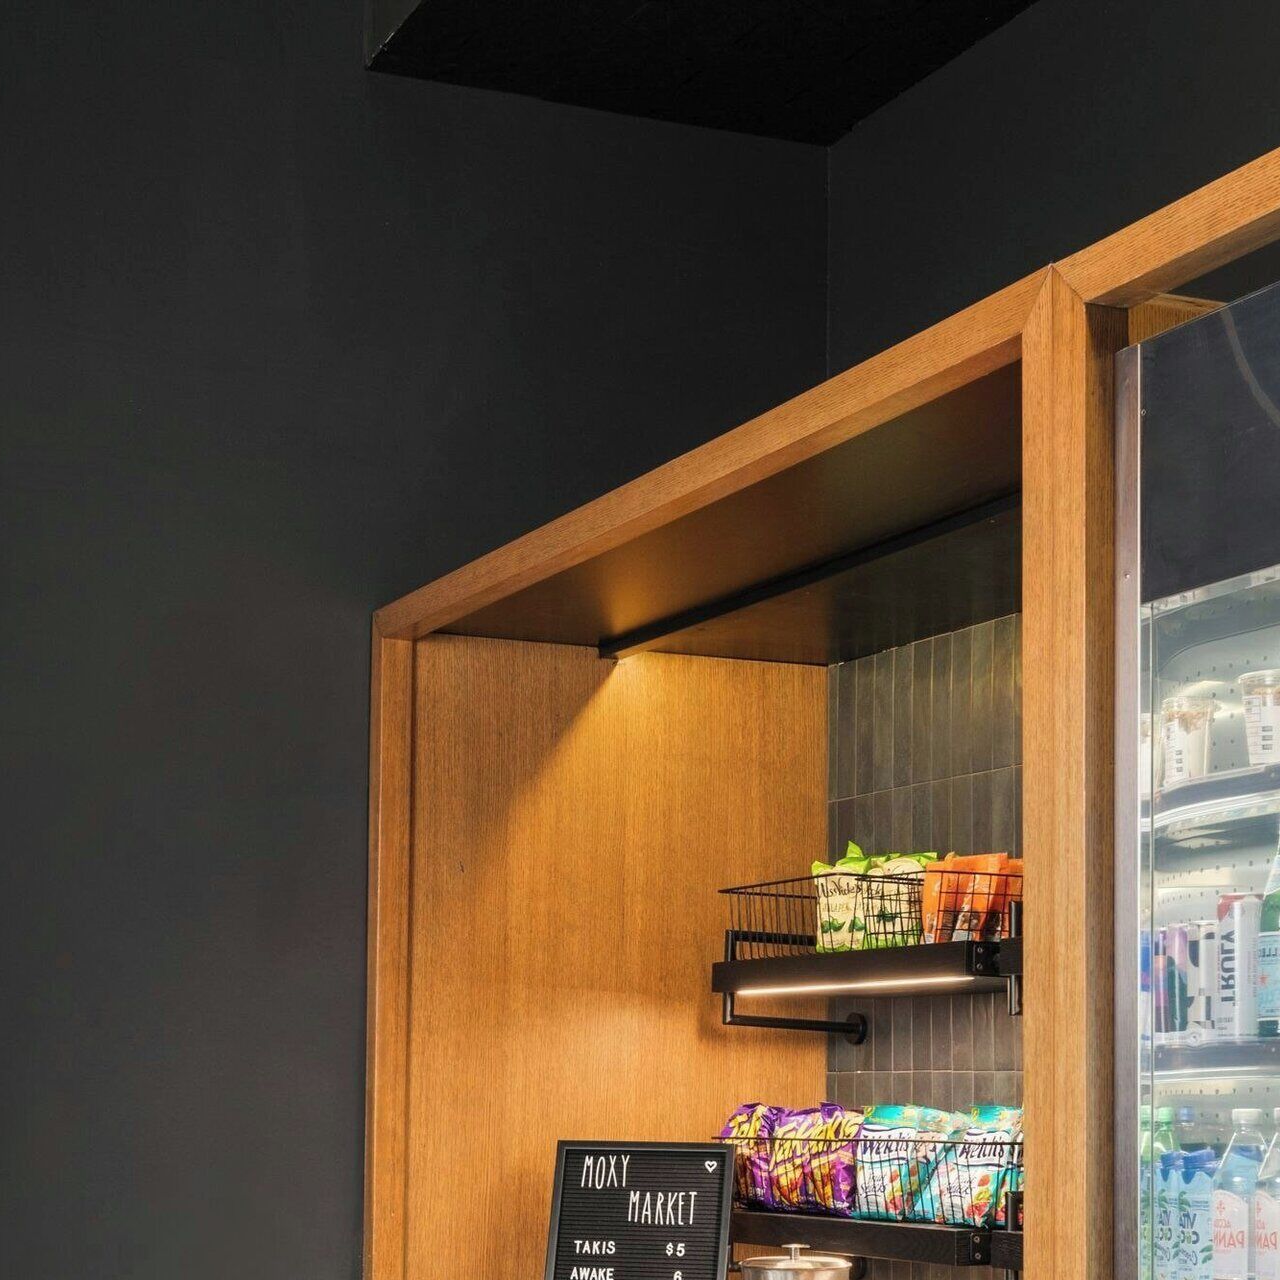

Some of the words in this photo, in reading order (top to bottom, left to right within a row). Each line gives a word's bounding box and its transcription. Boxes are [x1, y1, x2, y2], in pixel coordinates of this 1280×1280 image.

[862, 1131, 911, 1155] Welch's
[958, 1136, 1006, 1159] Welch's
[581, 1155, 630, 1190] MOXY
[628, 1190, 698, 1226] MARKET
[574, 1240, 616, 1255] TAKIS
[666, 1243, 686, 1257] $5
